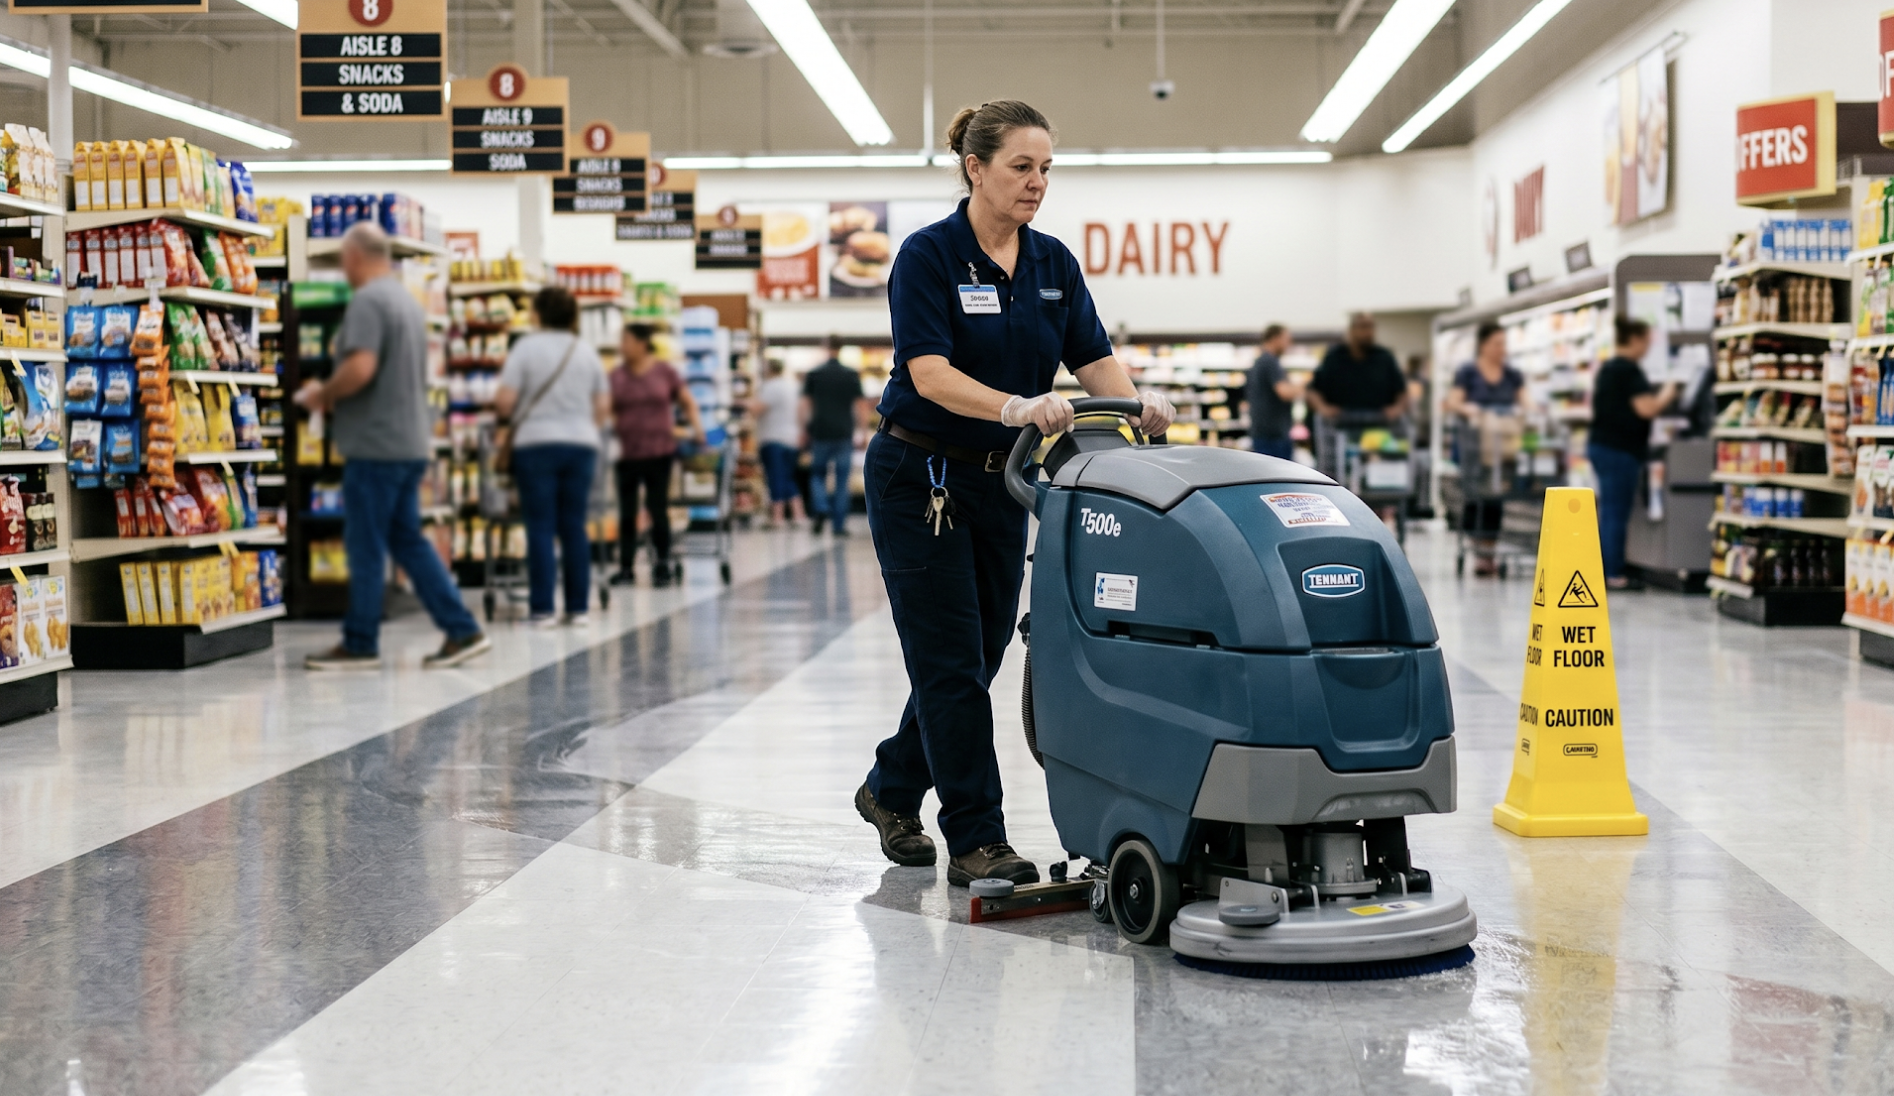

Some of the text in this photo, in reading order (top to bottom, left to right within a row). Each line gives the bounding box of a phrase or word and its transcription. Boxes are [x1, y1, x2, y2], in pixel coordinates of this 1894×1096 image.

[363, 0, 379, 21] 8
[340, 35, 403, 57] AISLE 8
[338, 64, 404, 85] SNACKS
[499, 72, 514, 97] 8
[341, 92, 404, 114] & SODA
[482, 108, 521, 126] AISLE
[480, 130, 535, 149] SNACKS
[489, 153, 527, 171] SODA
[1084, 220, 1230, 276] DAIRY
[1081, 507, 1122, 538] T500e
[1308, 573, 1359, 585] TENNANT
[1531, 623, 1543, 642] WET
[1561, 626, 1596, 644] WET
[1527, 645, 1542, 667] FLOOR
[1553, 650, 1605, 668] FLOOR
[1519, 702, 1539, 727] CAUTION
[1545, 708, 1614, 727] CAUTION
